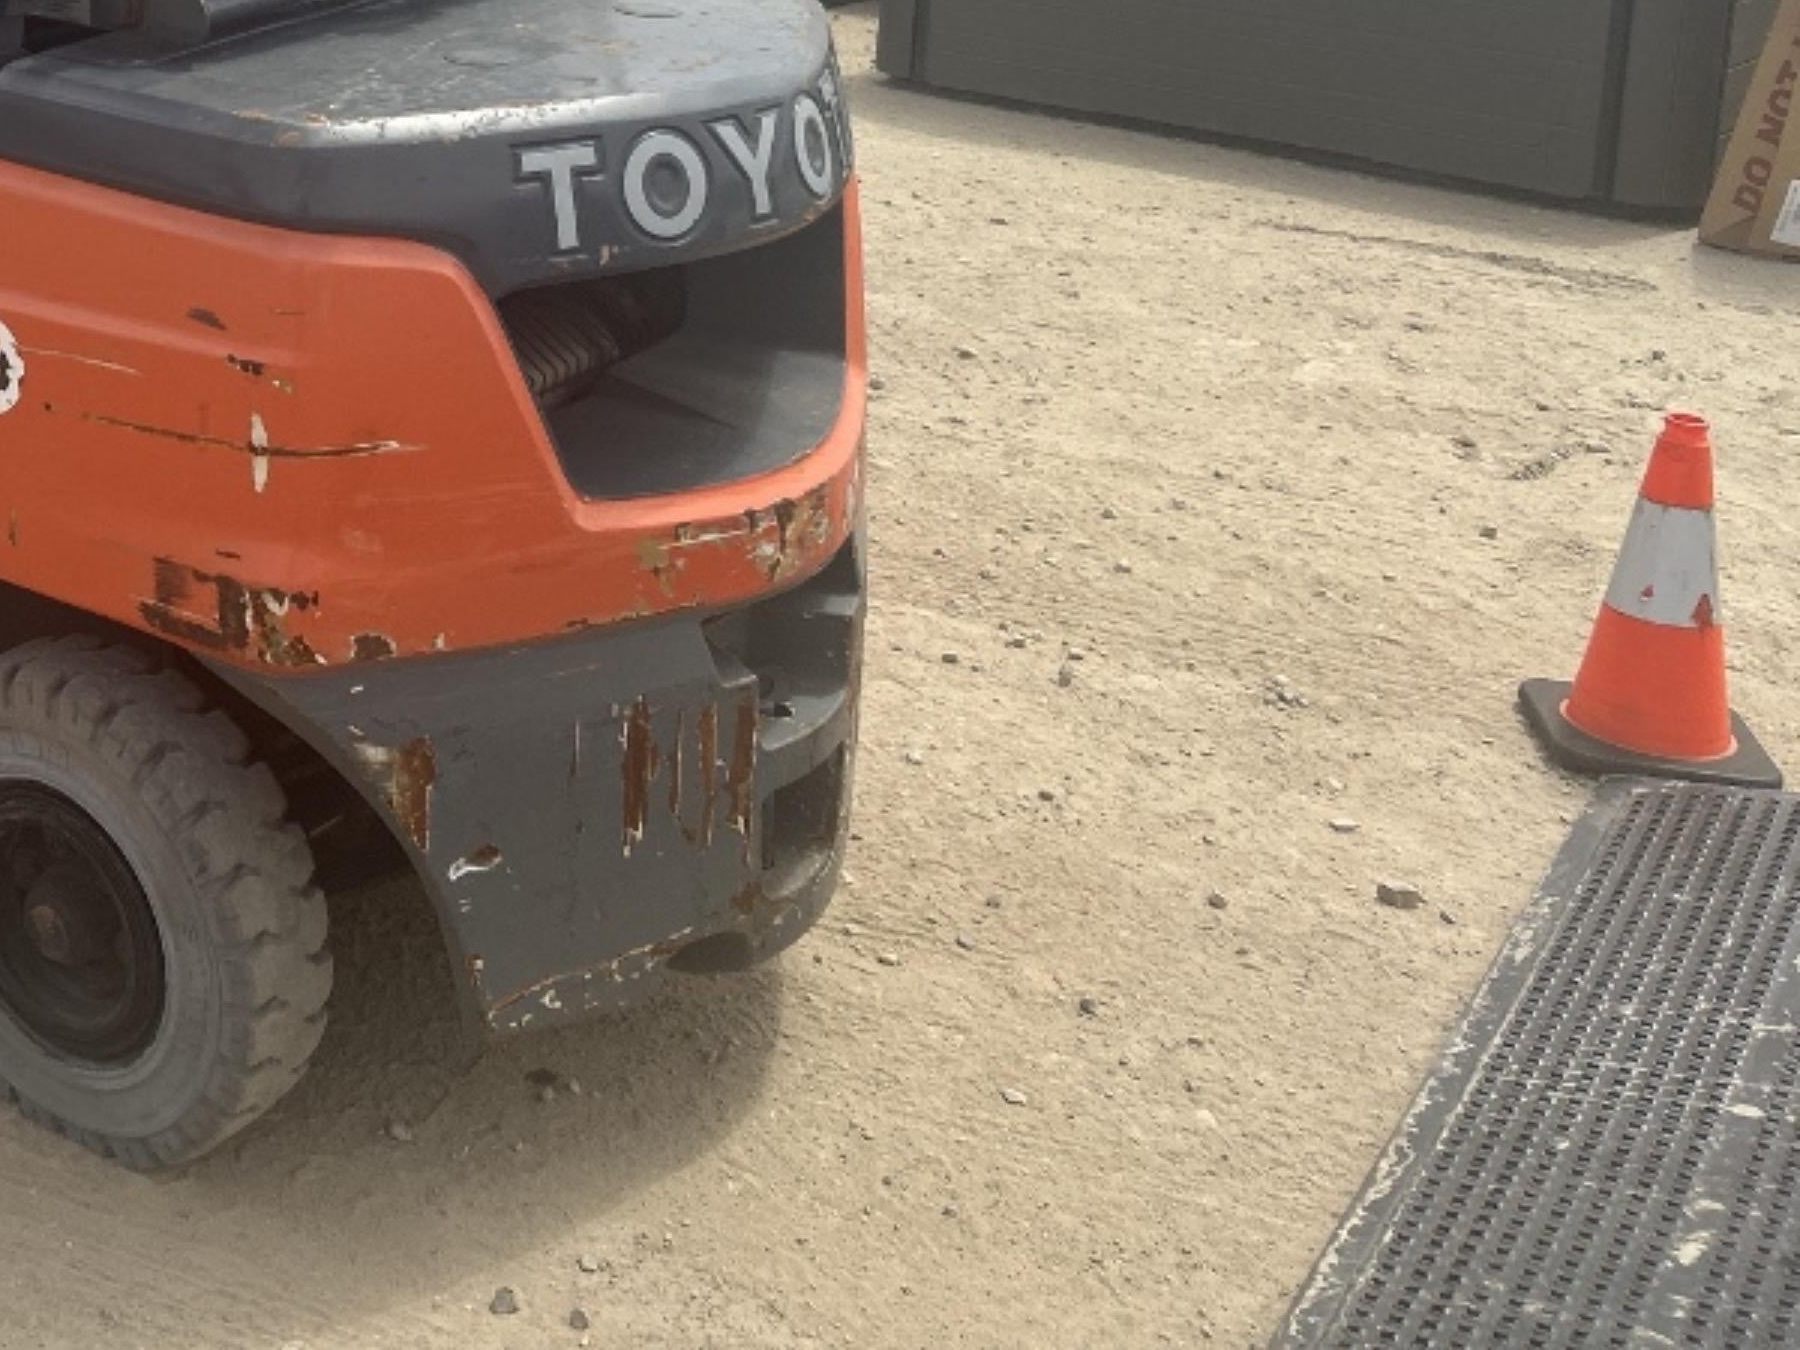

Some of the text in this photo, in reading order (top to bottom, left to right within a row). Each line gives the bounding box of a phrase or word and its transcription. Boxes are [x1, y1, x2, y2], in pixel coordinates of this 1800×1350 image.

[519, 92, 848, 252] TOYO
[1733, 155, 1773, 217] DO
[1755, 58, 1797, 149] NOT
